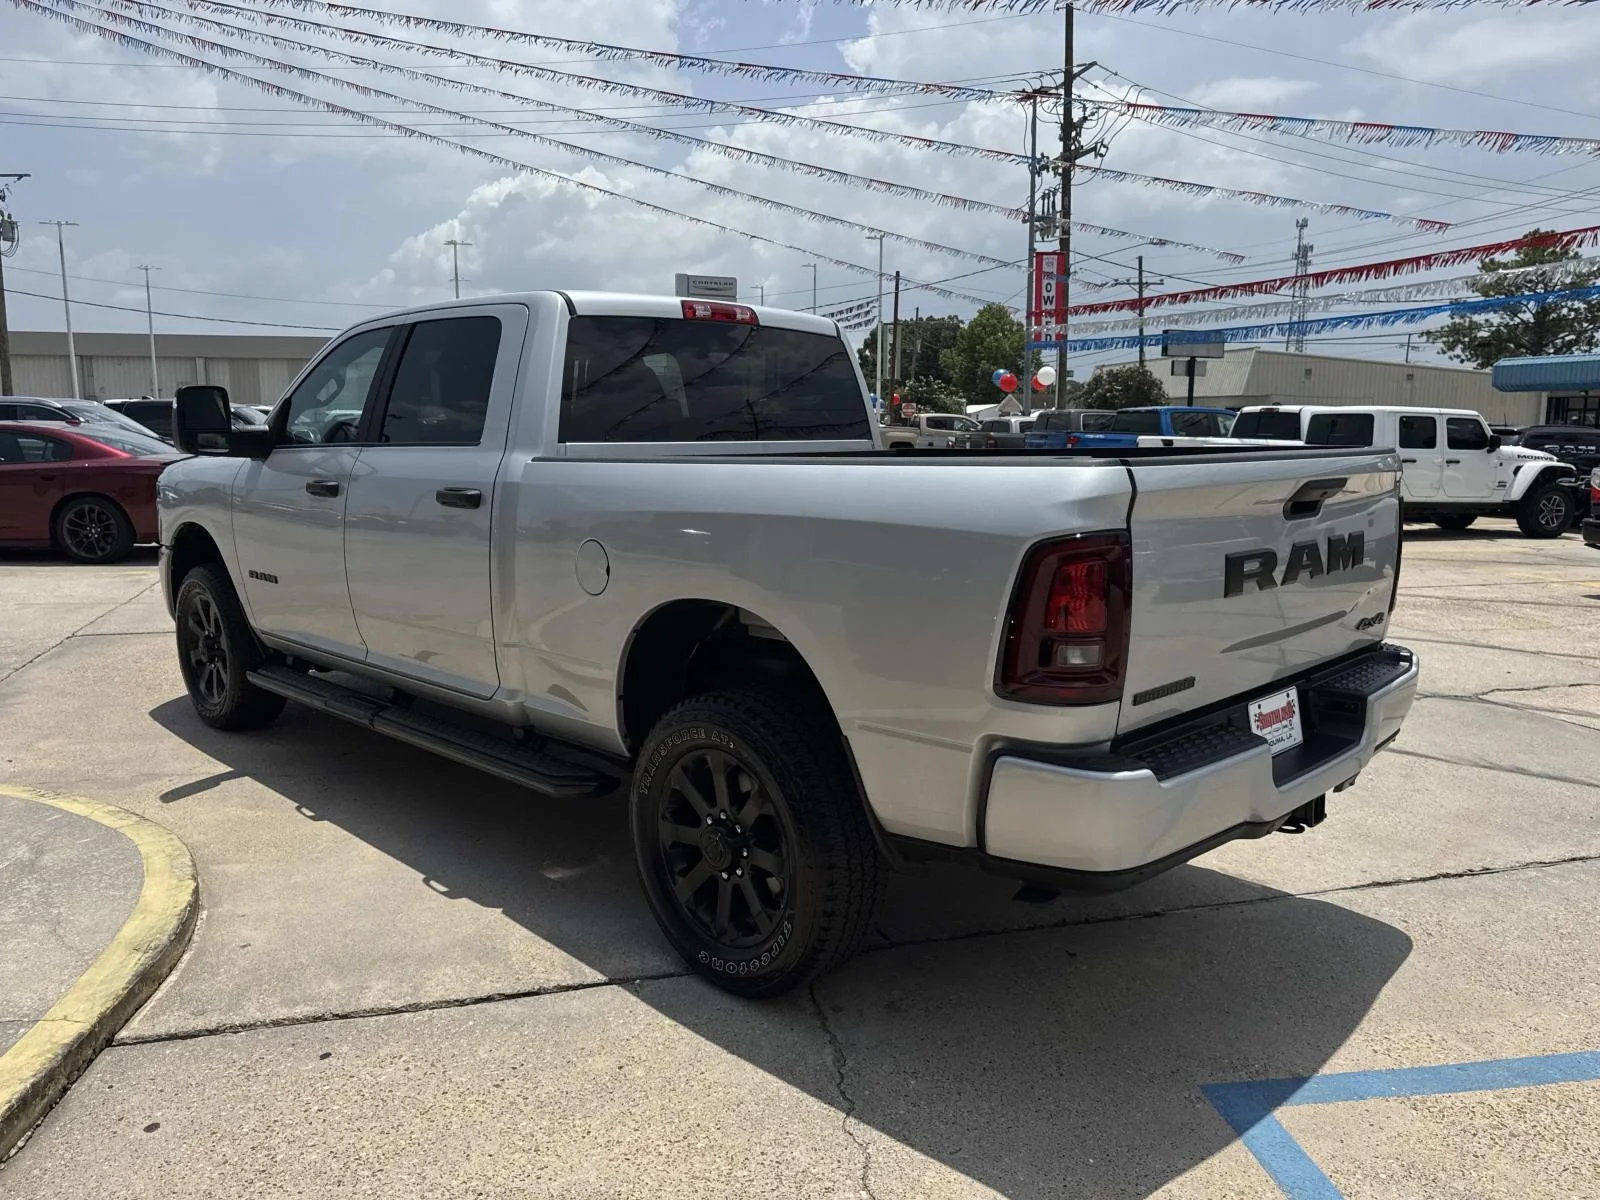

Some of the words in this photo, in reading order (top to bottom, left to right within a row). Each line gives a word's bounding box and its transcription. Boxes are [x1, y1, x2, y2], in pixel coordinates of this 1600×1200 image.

[1544, 444, 1596, 454] RAM
[248, 569, 278, 585] RAM
[1224, 530, 1364, 598] RAM
[640, 727, 706, 795] TRANSFORCE
